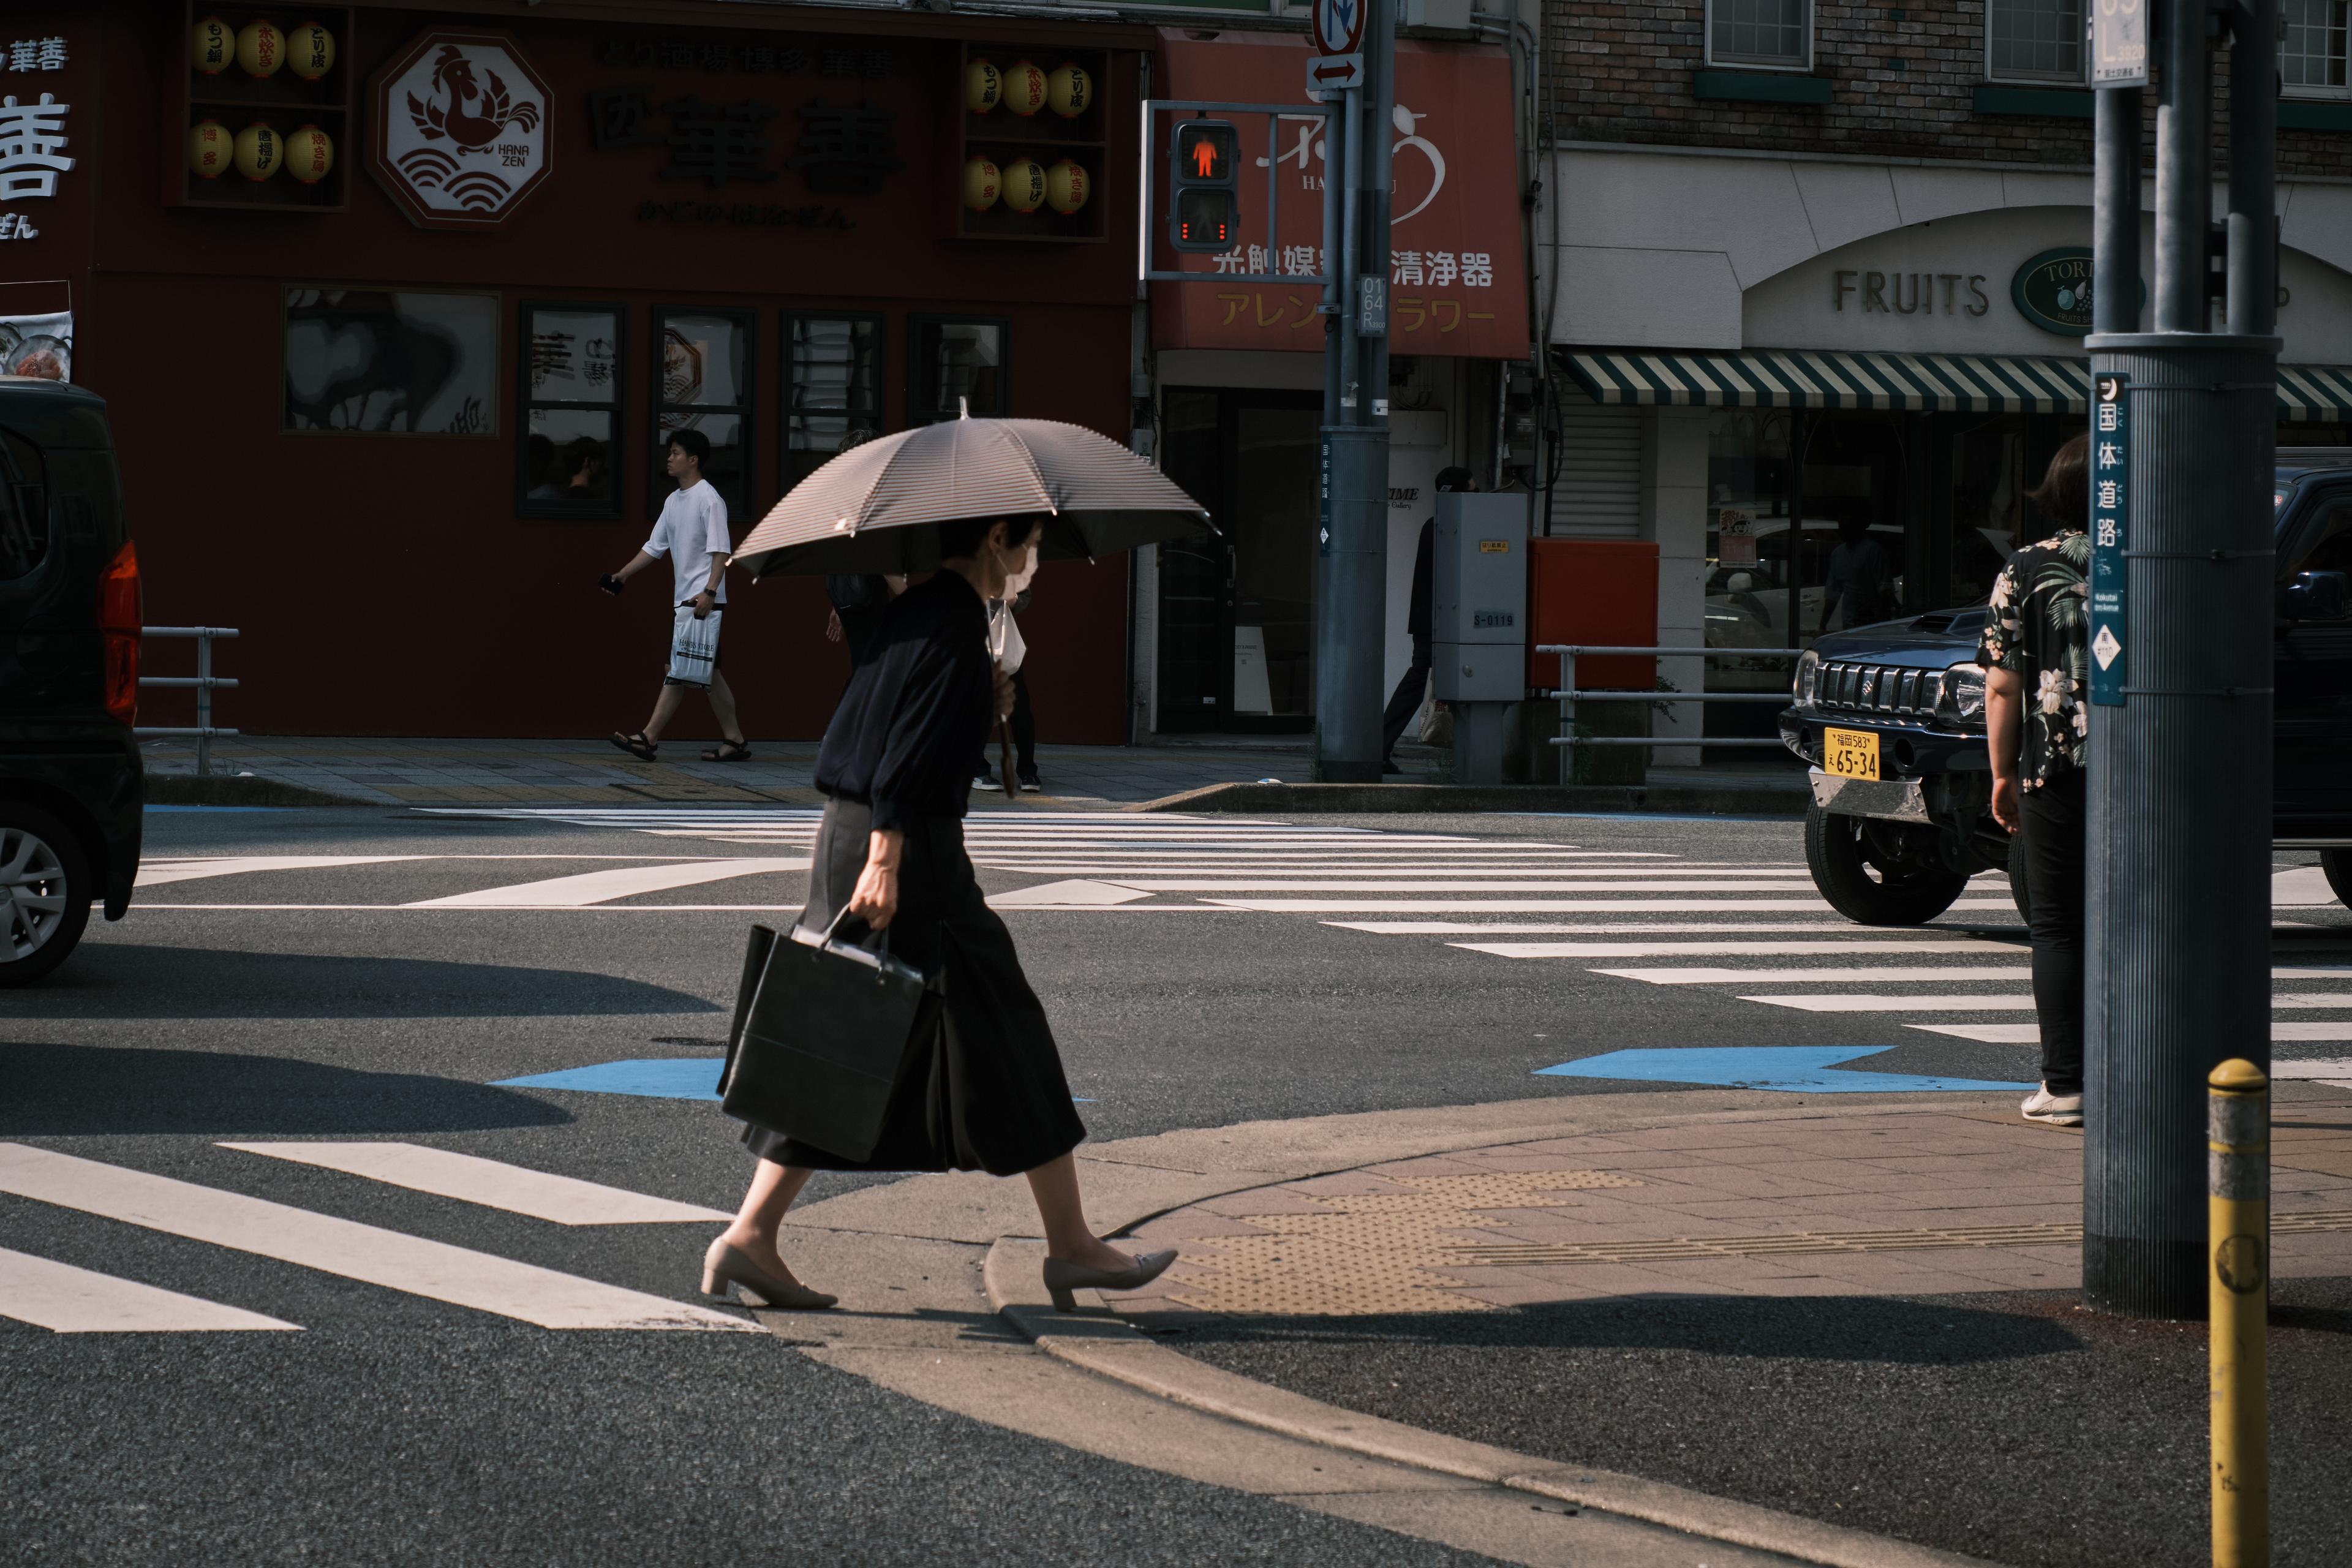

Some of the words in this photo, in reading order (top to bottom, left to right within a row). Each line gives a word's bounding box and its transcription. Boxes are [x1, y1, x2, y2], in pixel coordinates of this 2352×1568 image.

[0, 36, 70, 74] 華善
[498, 144, 529, 156] HANA
[502, 156, 526, 167] ZEN
[1212, 243, 1493, 287] 光触媒清浄器
[1364, 277, 1381, 293] 01
[1834, 270, 1990, 317] FRUITS
[1364, 295, 1384, 311] 64
[1216, 293, 1496, 333] アレンラワー
[1363, 311, 1373, 328] R
[2057, 312, 2081, 323] FRUITS
[2097, 403, 2117, 547] 国体道路
[1474, 614, 1513, 626] S-0119
[1837, 734, 1852, 747] 福岡
[1853, 736, 1867, 748] 583
[1837, 749, 1876, 777] 65-34
